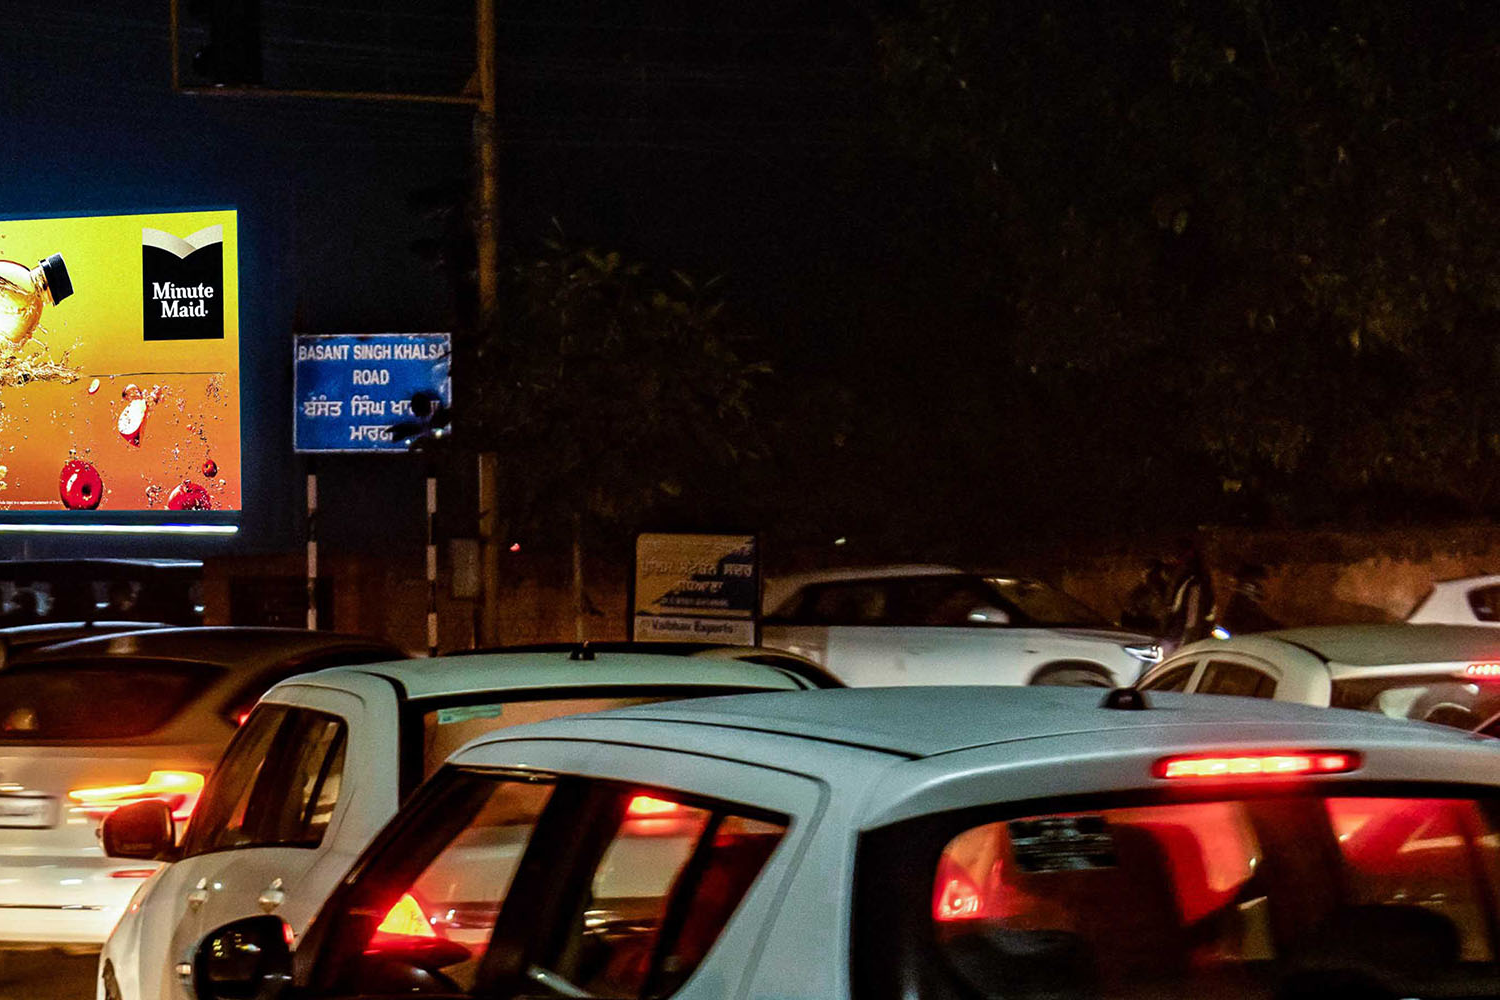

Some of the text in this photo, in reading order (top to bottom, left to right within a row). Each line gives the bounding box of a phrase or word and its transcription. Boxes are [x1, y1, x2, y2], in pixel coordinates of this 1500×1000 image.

[152, 281, 214, 299] Minute
[298, 343, 446, 361] BASANT SINGH KHALSA
[353, 369, 390, 385] ROAD
[351, 394, 386, 416] ਸਿੰਘ
